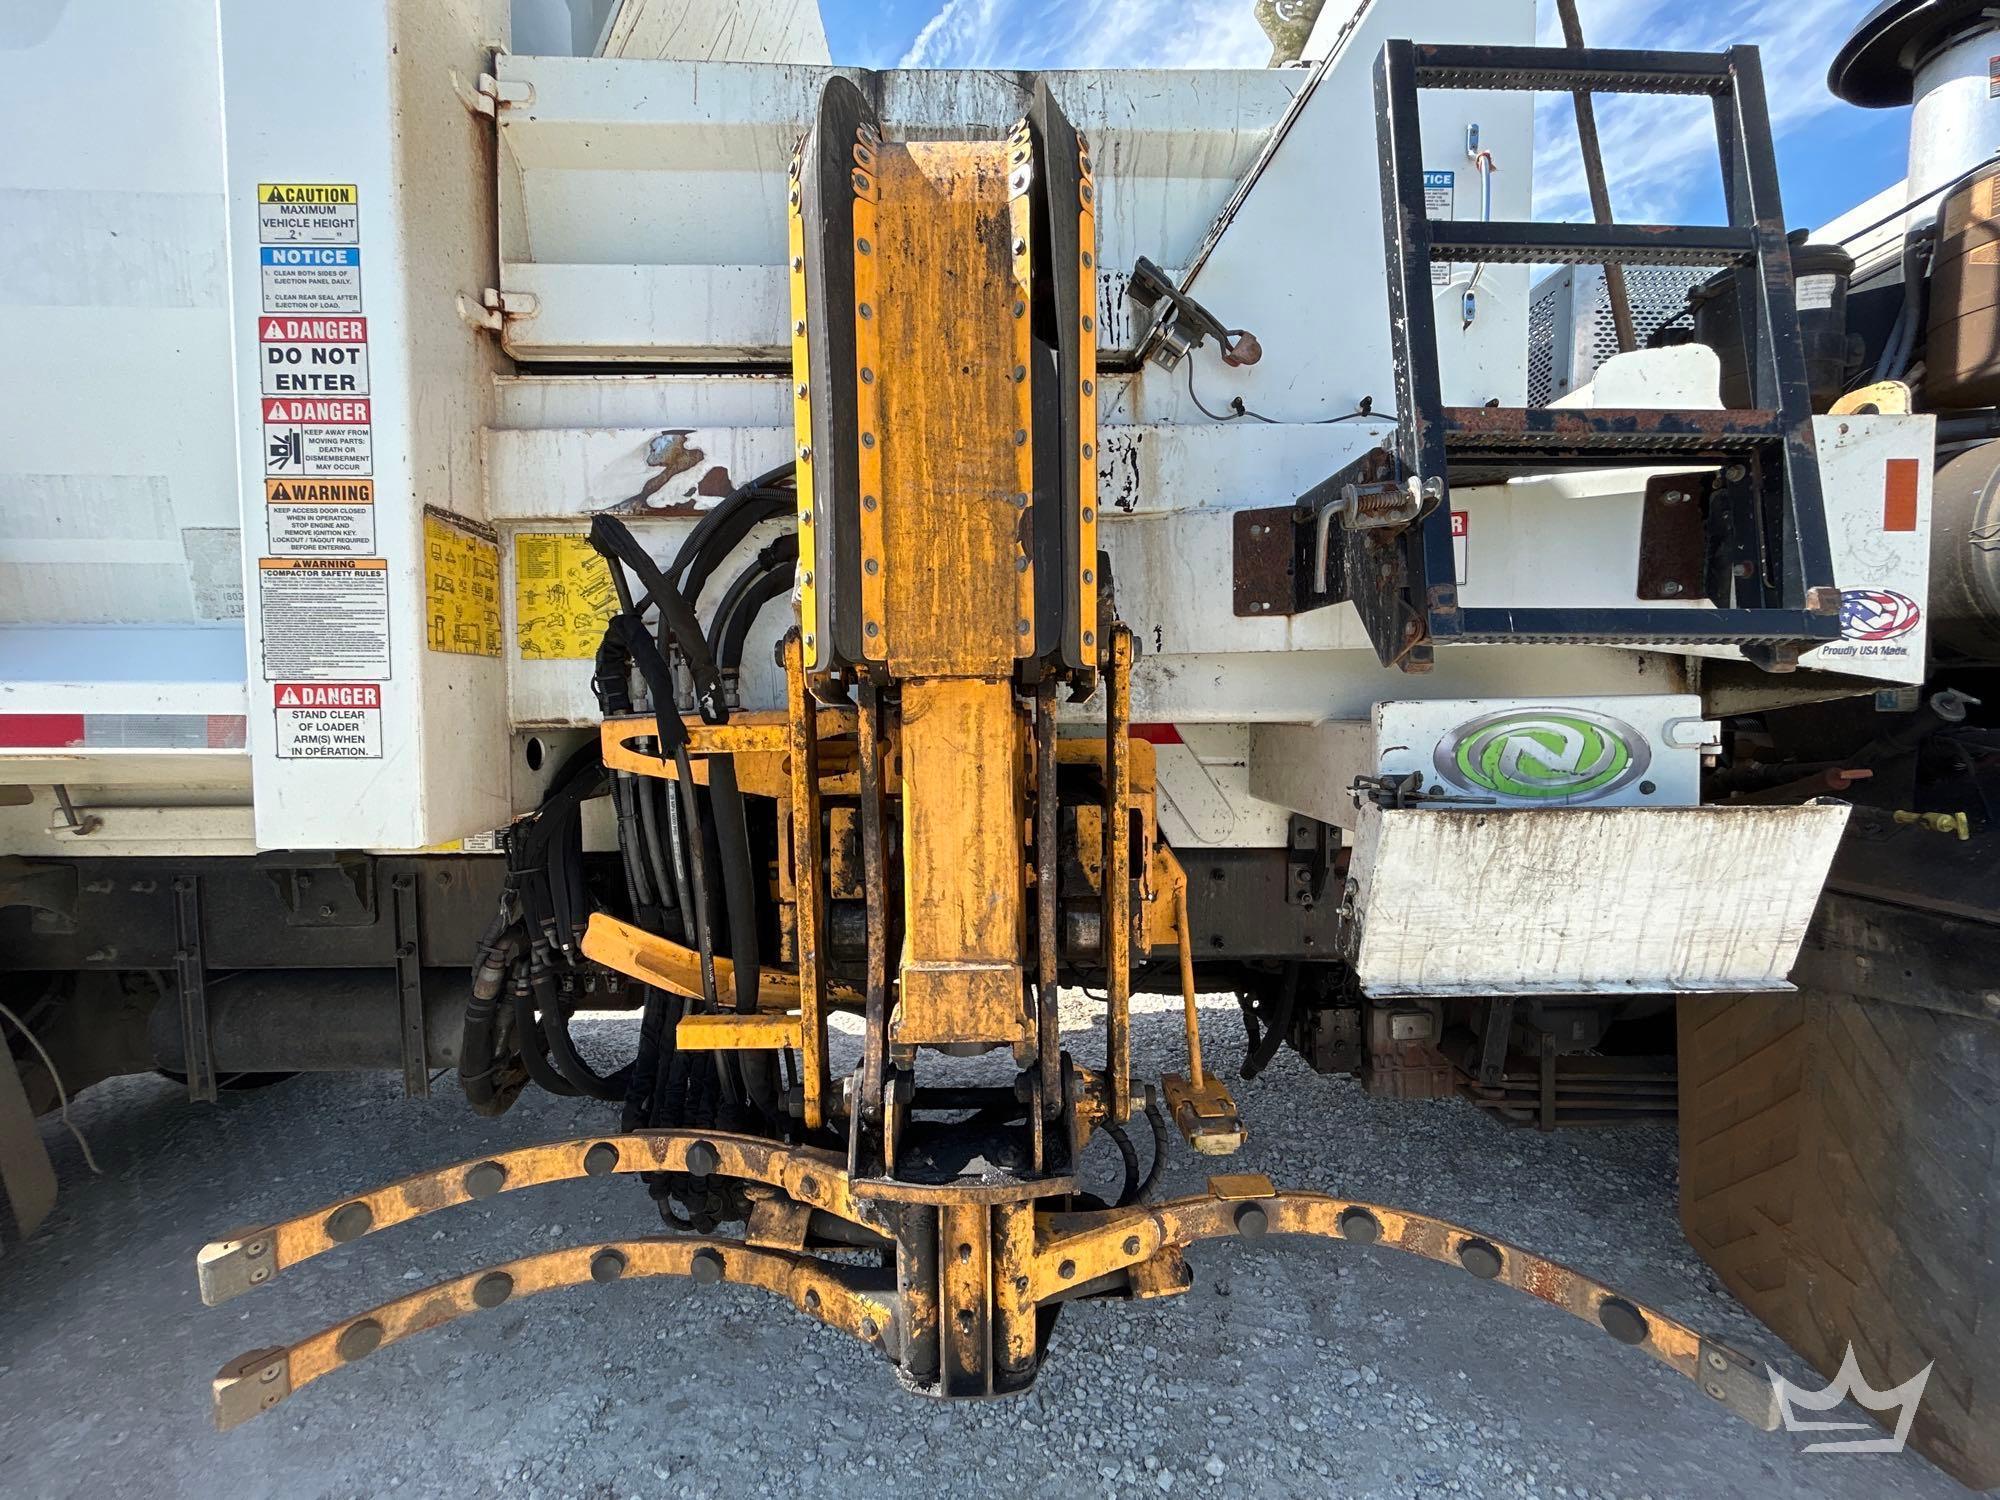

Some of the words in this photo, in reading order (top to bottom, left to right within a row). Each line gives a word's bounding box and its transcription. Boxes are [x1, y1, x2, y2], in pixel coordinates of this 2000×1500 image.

[1424, 174, 1452, 184] TICE
[285, 188, 349, 202] CAUTION
[280, 205, 337, 215] MAXIMUM
[263, 219, 310, 228] VEHICLE
[313, 219, 355, 228] HEIGHT
[272, 249, 348, 264] NOTICE
[286, 321, 363, 339] DANGER
[268, 347, 302, 364] DO
[311, 347, 360, 364] NOT
[276, 374, 356, 390] ENTER
[290, 402, 367, 421] DANGER
[292, 485, 370, 500] WARNING
[303, 560, 356, 568] WARNING
[1822, 646, 1857, 656] Proudly
[1859, 646, 1878, 655] USA
[301, 688, 376, 705] DANGER
[292, 711, 327, 719] STAND
[329, 711, 365, 719] CLEAR
[299, 723, 314, 731] OF
[316, 723, 359, 731] LOADER
[293, 735, 331, 745] ARM(S)
[333, 735, 365, 743] WHEN
[305, 748, 369, 756] OPERATION.
